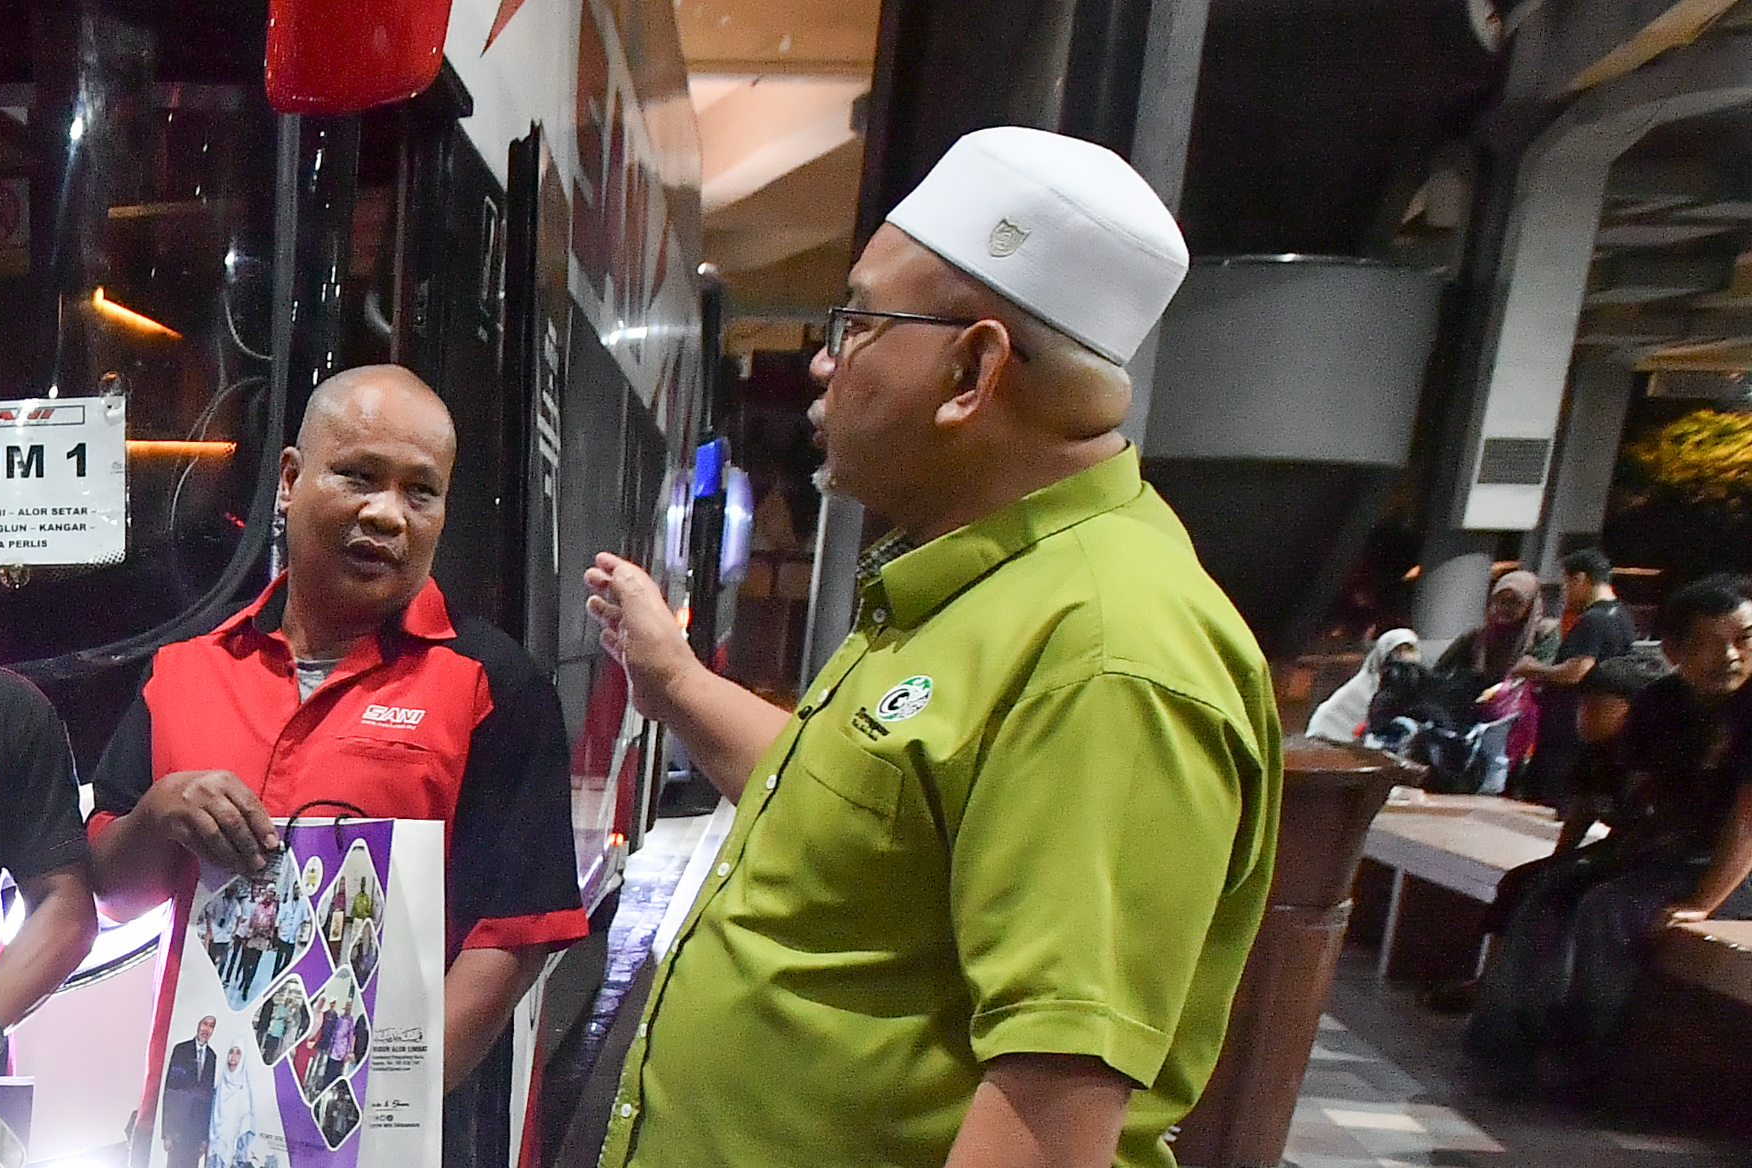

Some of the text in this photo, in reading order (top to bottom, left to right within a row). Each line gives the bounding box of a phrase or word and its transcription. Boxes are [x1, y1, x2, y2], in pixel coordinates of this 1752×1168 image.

[66, 442, 87, 478] 1
[17, 508, 48, 517] ALOR
[51, 506, 89, 516] SETAR
[39, 523, 87, 533] KANGAR
[8, 539, 48, 549] PERLIS
[361, 704, 426, 725] SANI
